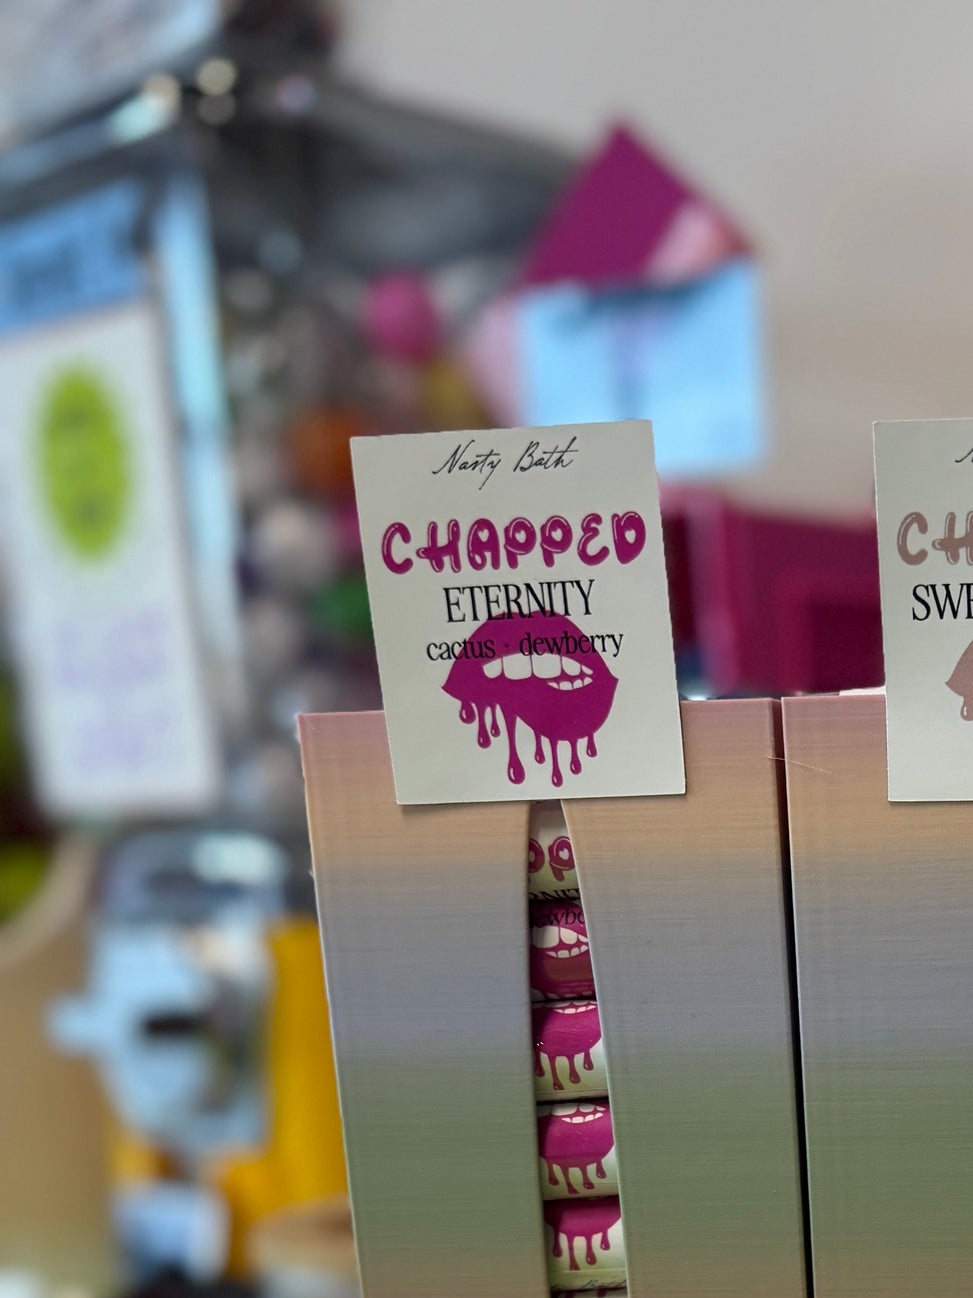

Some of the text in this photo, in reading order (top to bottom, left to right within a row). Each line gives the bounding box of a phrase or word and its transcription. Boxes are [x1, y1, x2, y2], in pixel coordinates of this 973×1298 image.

[432, 436, 579, 490] Nasty Bath
[381, 511, 647, 575] CHAPPED
[442, 579, 596, 623] ETERNITY
[427, 631, 624, 662] cactus dewberry
